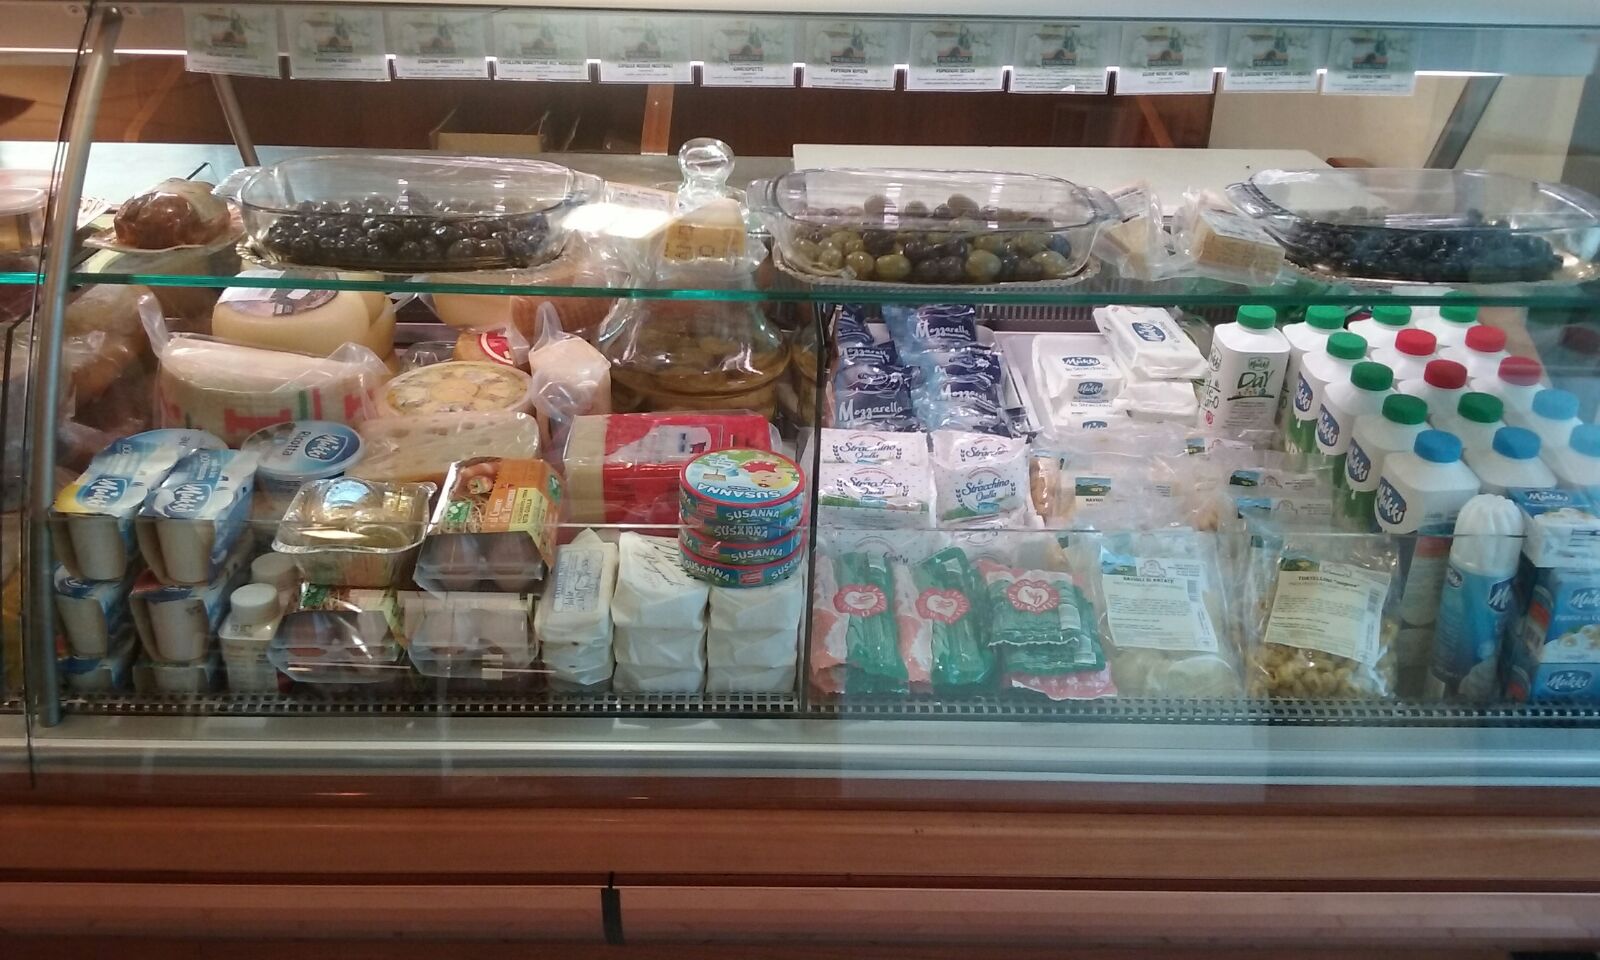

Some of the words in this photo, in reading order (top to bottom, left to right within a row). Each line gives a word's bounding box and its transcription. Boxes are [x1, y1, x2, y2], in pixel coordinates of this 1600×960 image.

[916, 320, 972, 339] Mozzarella
[838, 398, 903, 422] Mozzarella
[282, 431, 312, 456] Ricotta
[697, 482, 782, 499] SUSANNA
[961, 477, 1010, 496] Stracchino
[725, 508, 781, 522] SUSANNA
[714, 525, 769, 539] SUSANNA
[730, 548, 784, 562] SUSANNA
[684, 559, 731, 582] SUSANNA
[1546, 671, 1592, 689] Mukki
